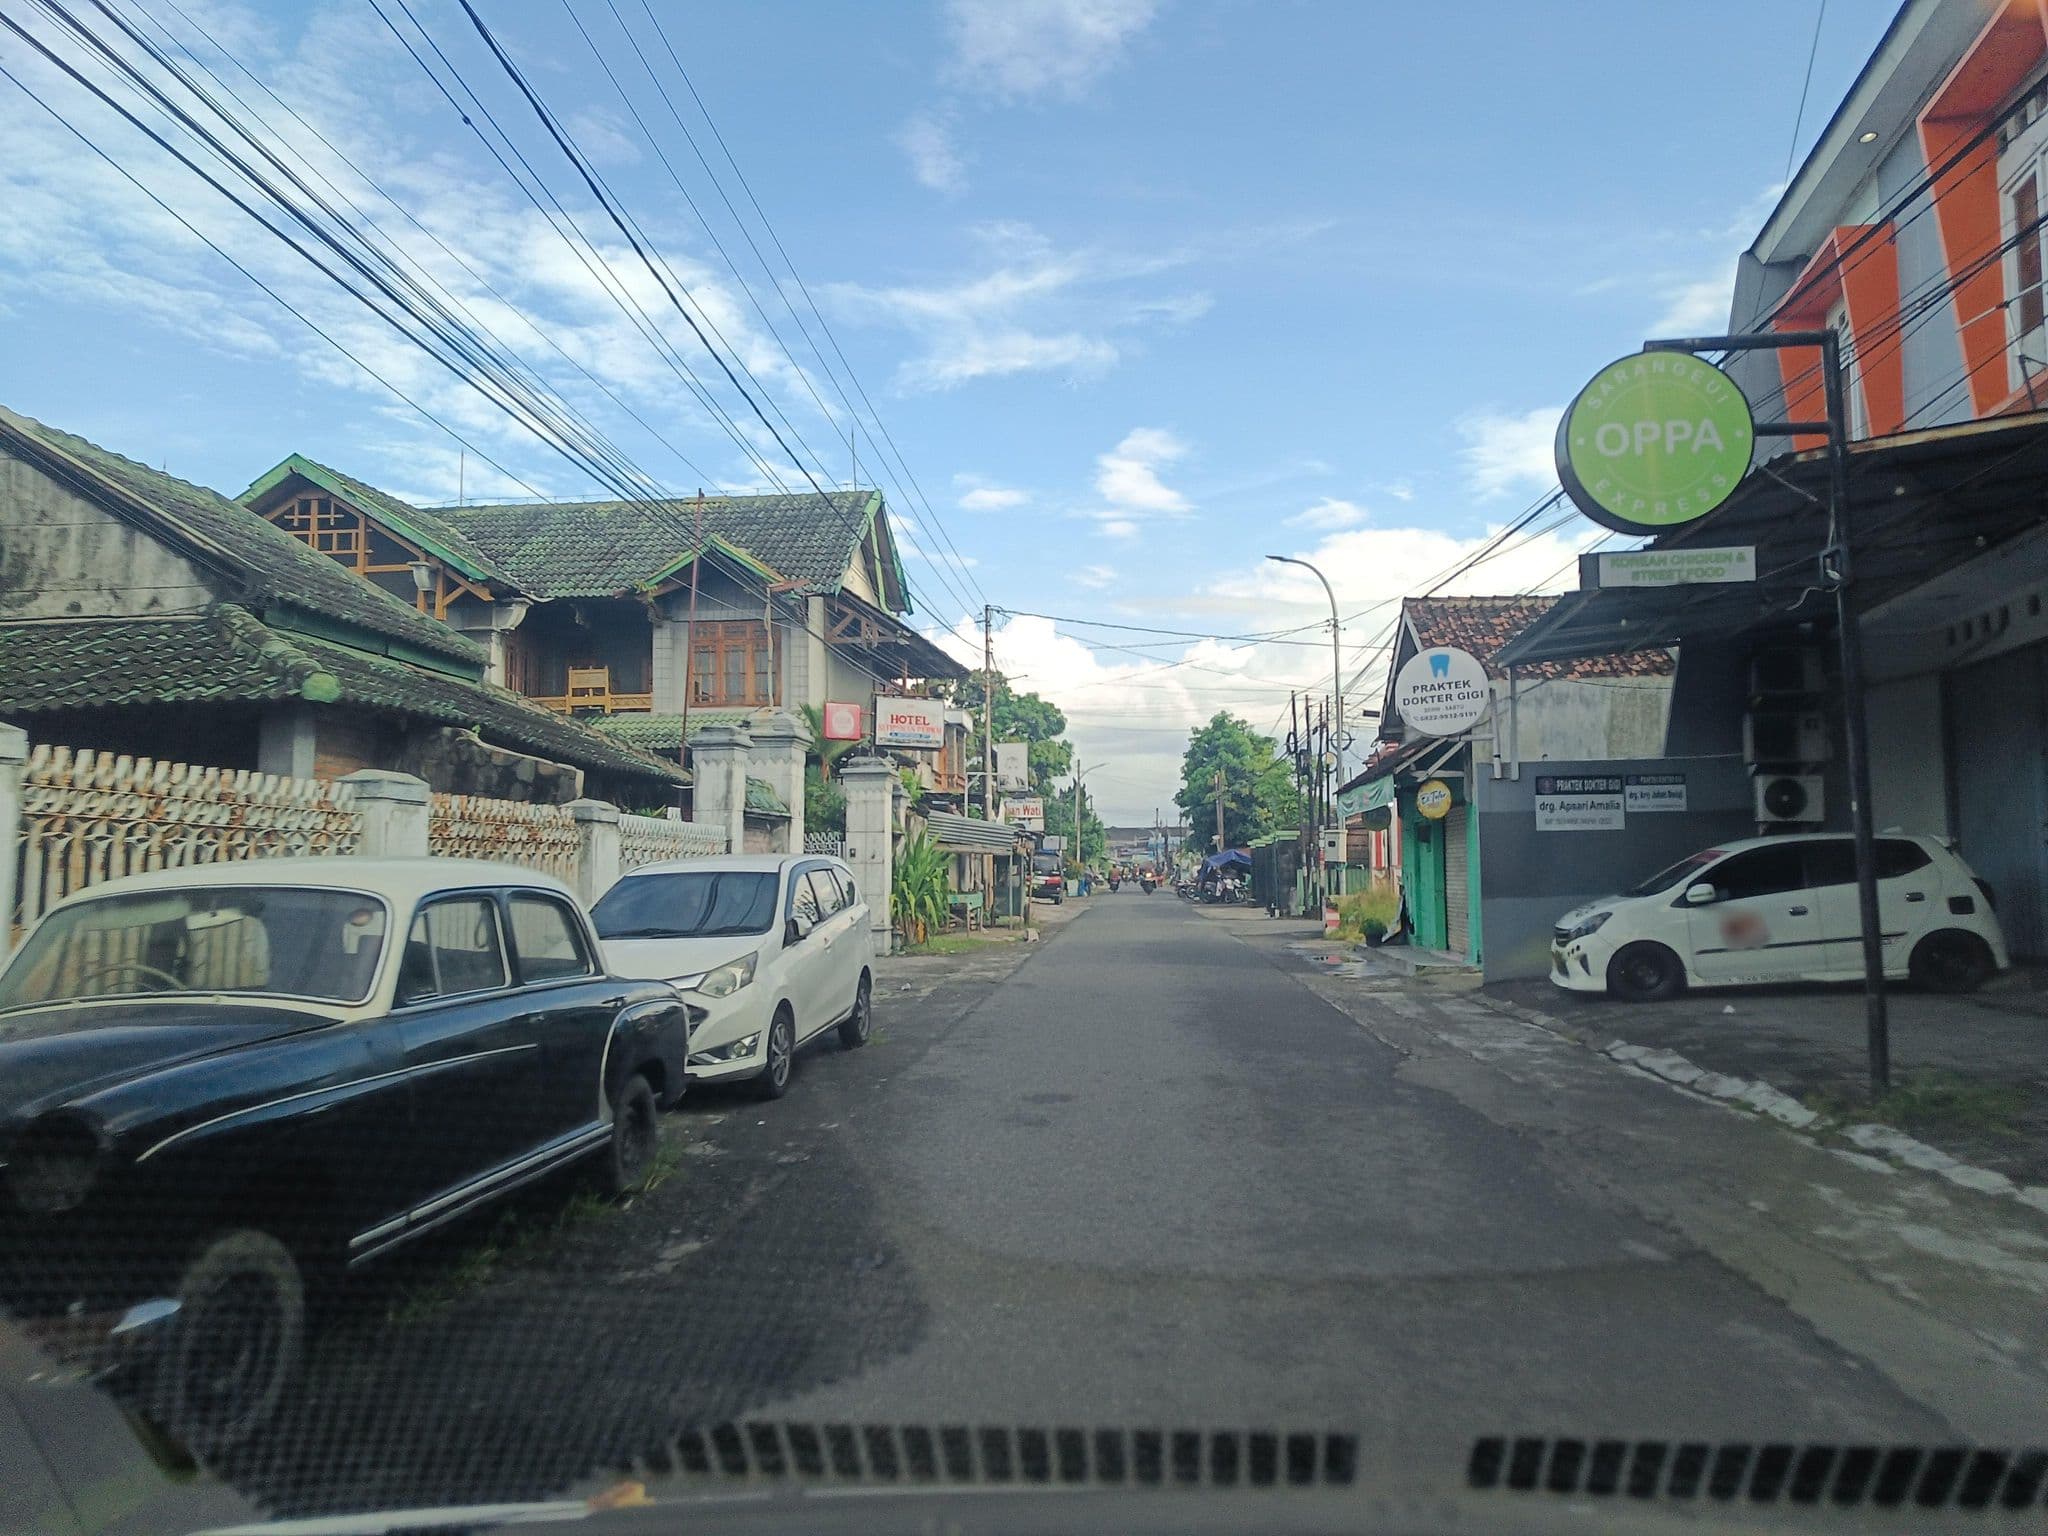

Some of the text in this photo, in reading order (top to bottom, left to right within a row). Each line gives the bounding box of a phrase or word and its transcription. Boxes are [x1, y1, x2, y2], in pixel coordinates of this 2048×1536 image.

[1595, 418, 1725, 458] OPPA
[1595, 473, 1728, 517] EXPRESS
[1610, 555, 1667, 568] KOREAN
[1670, 552, 1733, 566] CHICKEN
[1631, 567, 1726, 581] STREET FOOD
[1412, 679, 1472, 694] PRAKTEK
[1402, 690, 1484, 706] DOKTER GIGI
[890, 714, 930, 726] HOTEL
